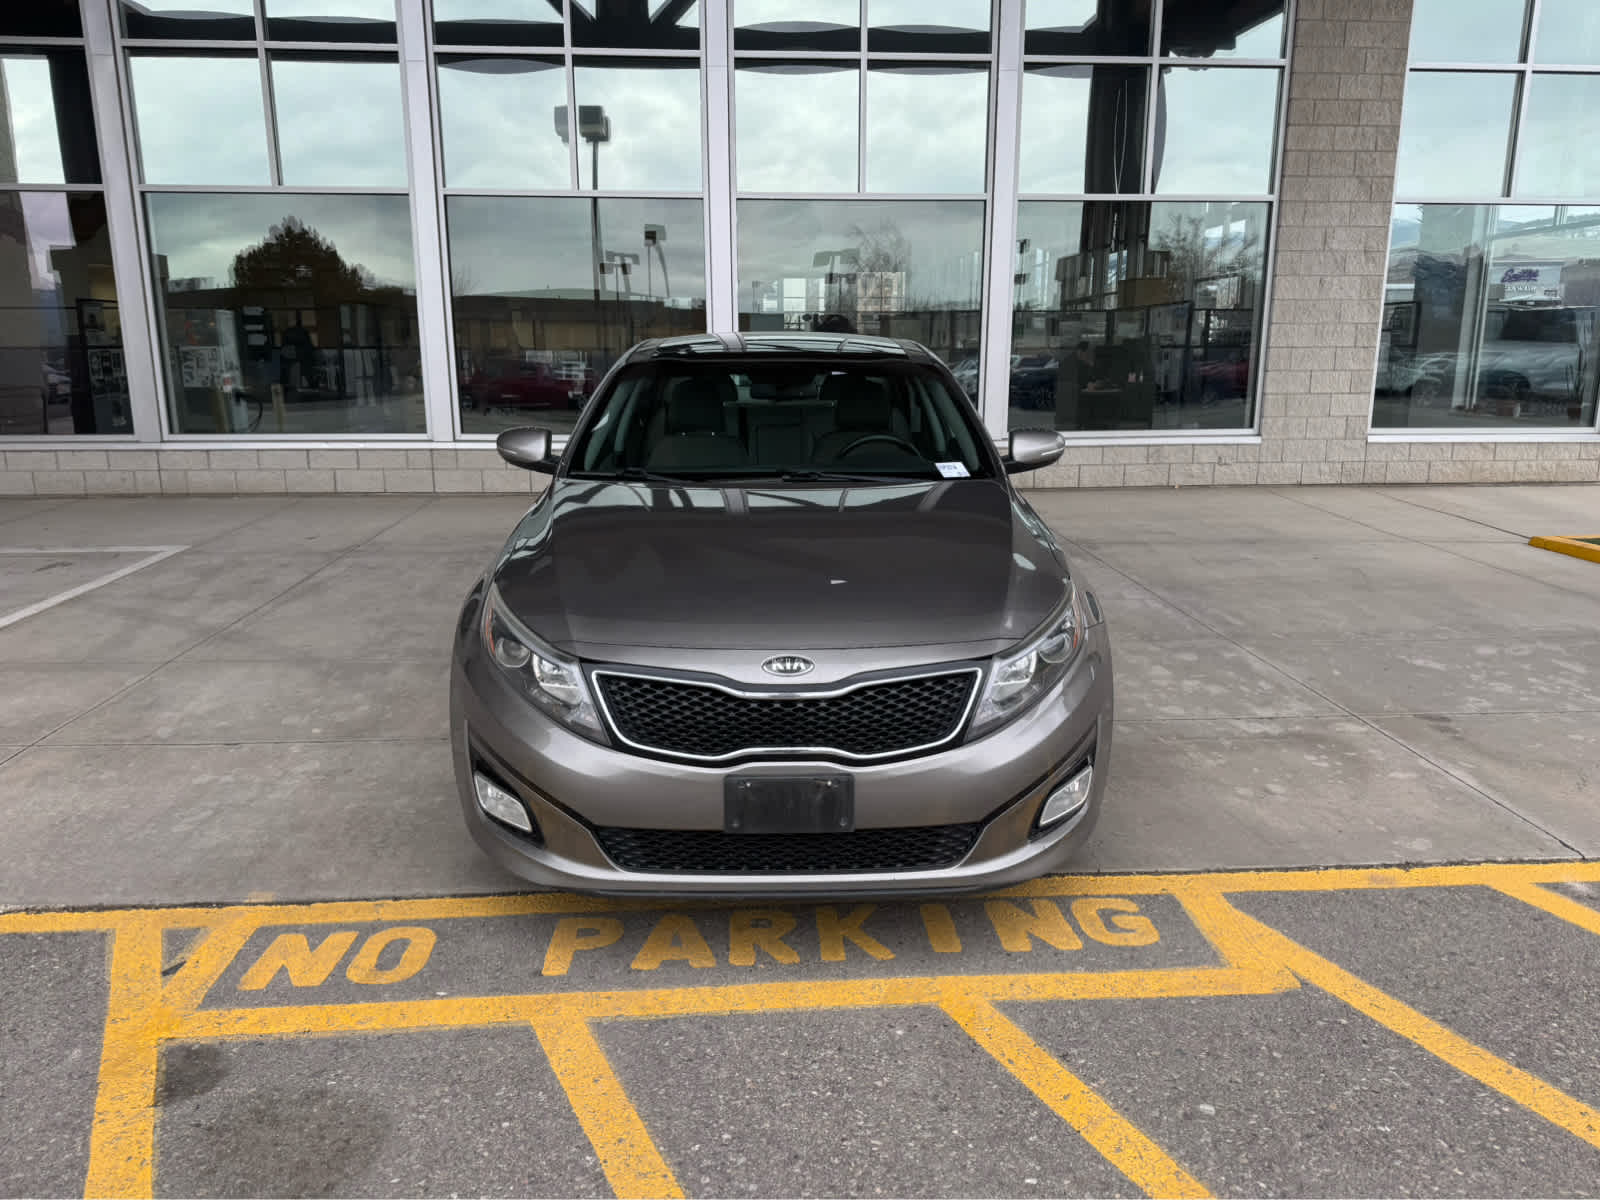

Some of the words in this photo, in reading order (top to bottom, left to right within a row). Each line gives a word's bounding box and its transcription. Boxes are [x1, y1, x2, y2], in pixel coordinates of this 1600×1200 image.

[771, 656, 807, 671] KIA
[237, 925, 437, 991] NO
[540, 897, 1161, 976] PARKING
